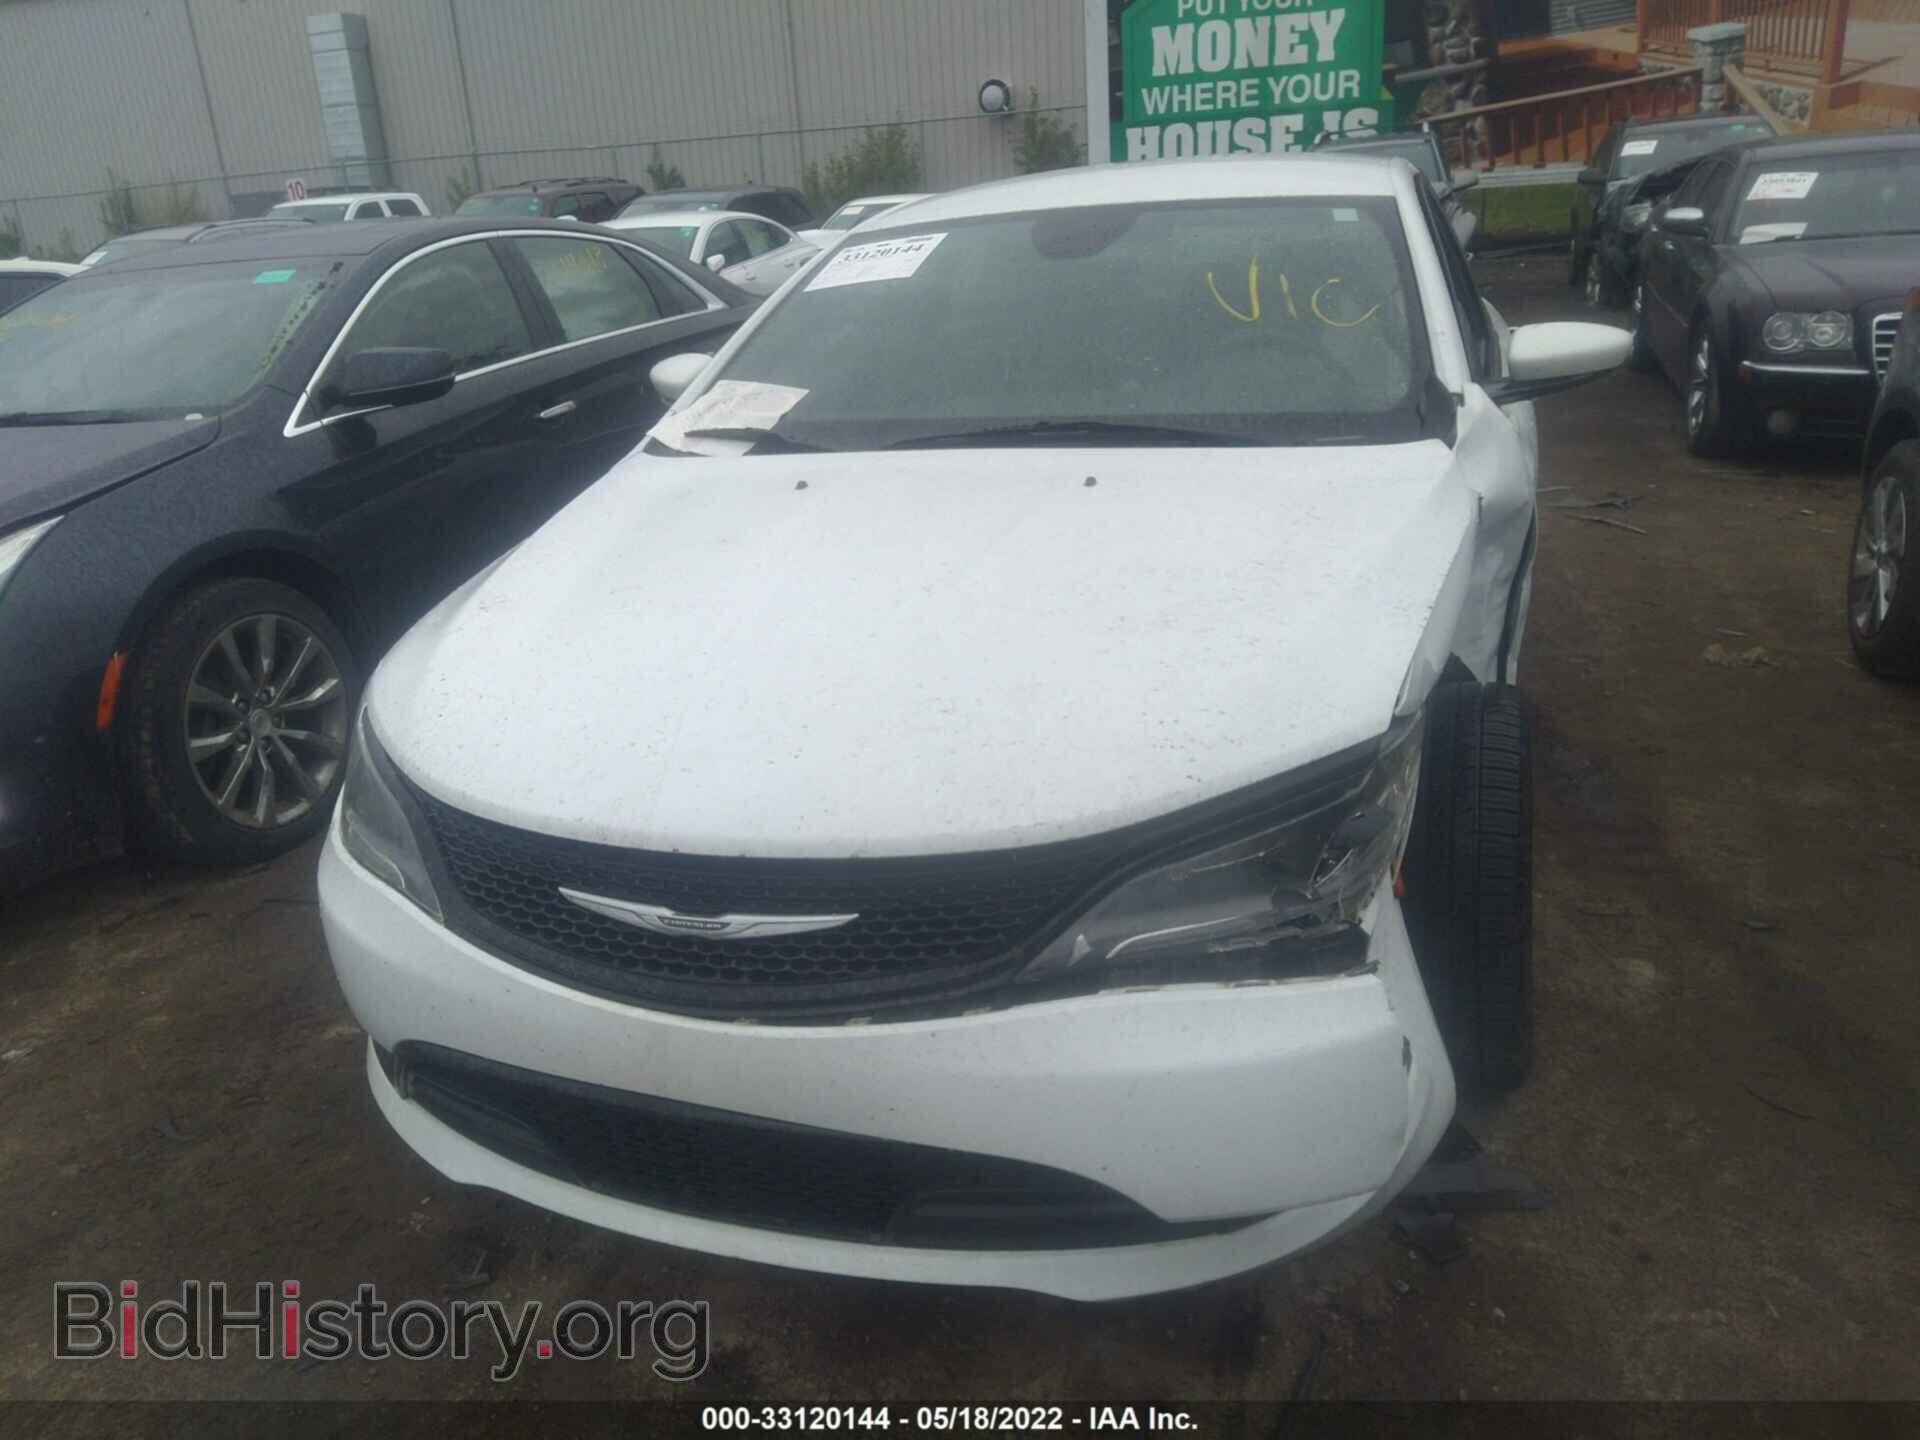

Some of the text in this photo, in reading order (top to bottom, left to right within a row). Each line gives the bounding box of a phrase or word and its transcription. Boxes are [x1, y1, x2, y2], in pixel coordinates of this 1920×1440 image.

[1177, 0, 1226, 18] PUT
[1151, 8, 1346, 77] MONEY
[1141, 69, 1361, 115] WHERE YOUR
[1125, 113, 1304, 162] HOUSE
